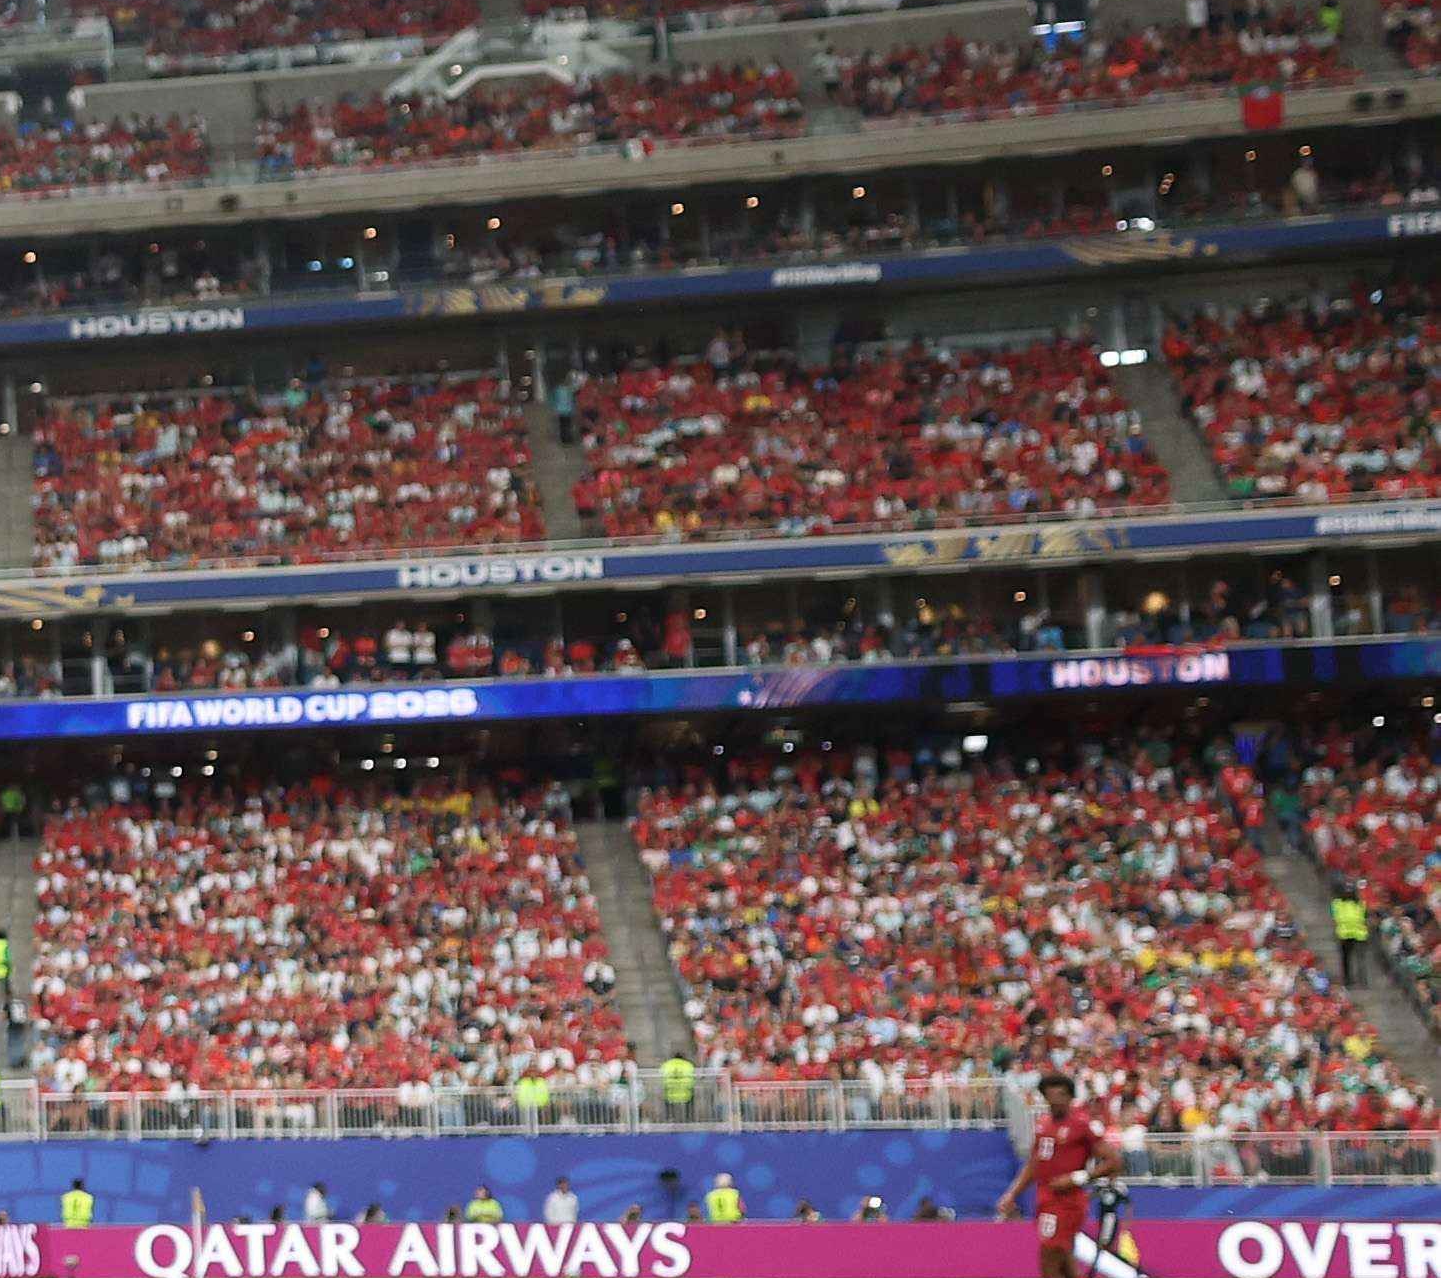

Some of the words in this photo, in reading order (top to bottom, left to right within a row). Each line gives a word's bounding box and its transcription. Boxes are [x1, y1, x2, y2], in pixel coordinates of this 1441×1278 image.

[71, 308, 244, 340] HOUSTON
[399, 556, 605, 587] HOUSTON
[1052, 652, 1230, 689] HOUSTON
[127, 700, 194, 729] FIFA
[192, 696, 305, 725] WORLD
[303, 693, 369, 722] CUP
[368, 688, 478, 719] 2026
